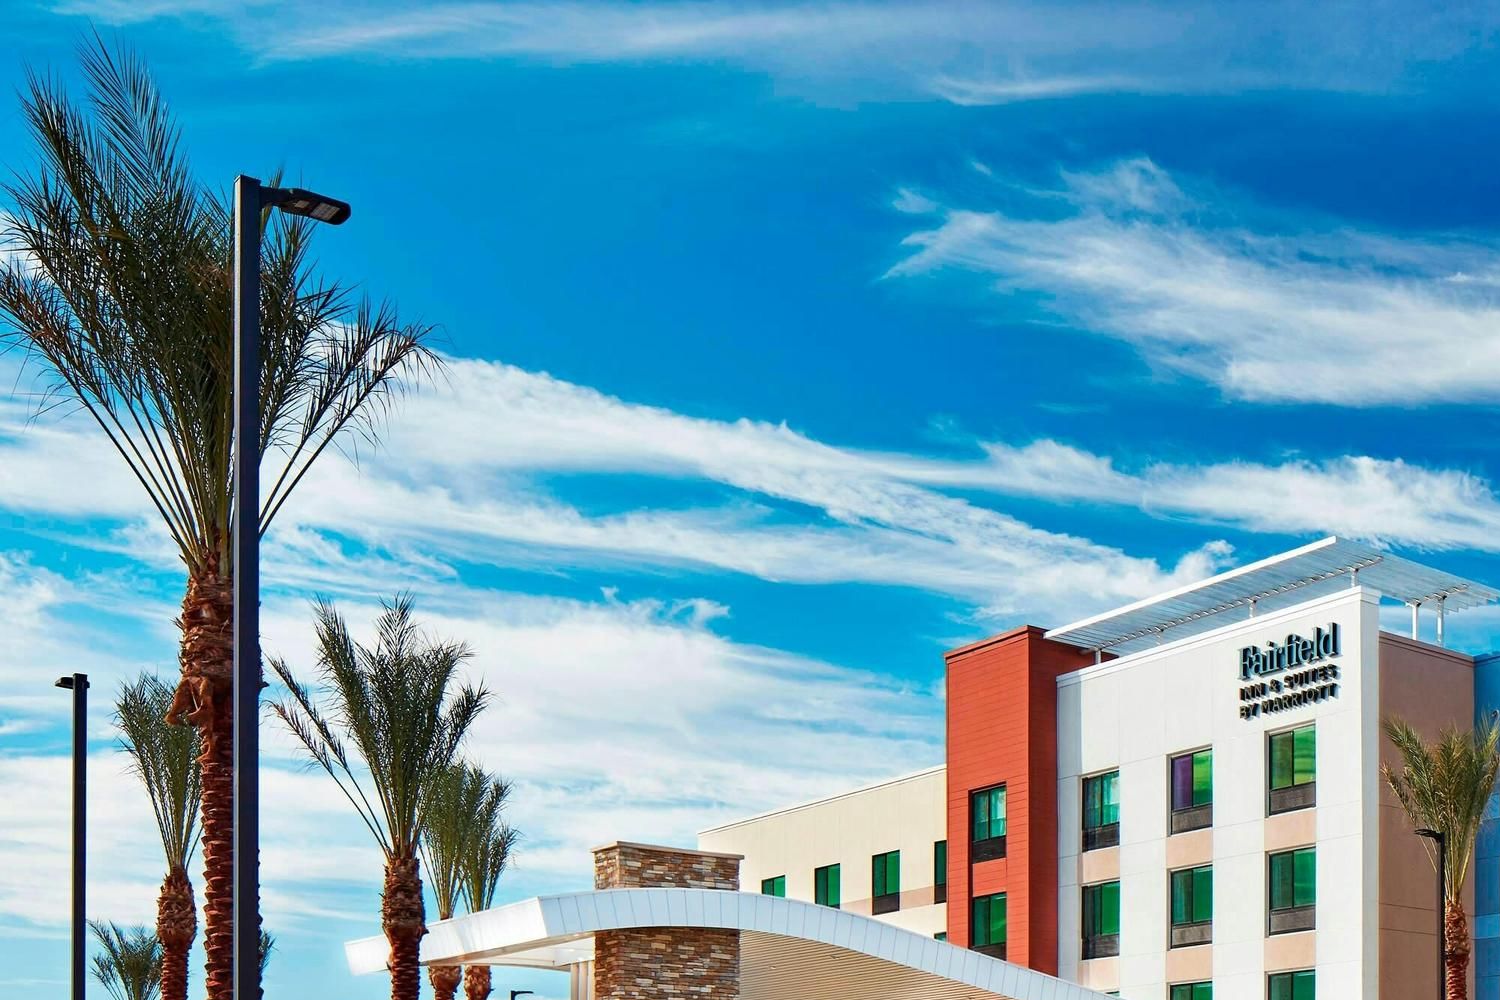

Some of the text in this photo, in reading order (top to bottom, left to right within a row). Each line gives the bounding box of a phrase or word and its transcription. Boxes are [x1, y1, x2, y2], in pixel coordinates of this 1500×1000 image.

[1238, 622, 1342, 680] Fairfield
[1239, 663, 1340, 701] INN & SUITES
[1239, 682, 1339, 719] BY MARRIOTT
